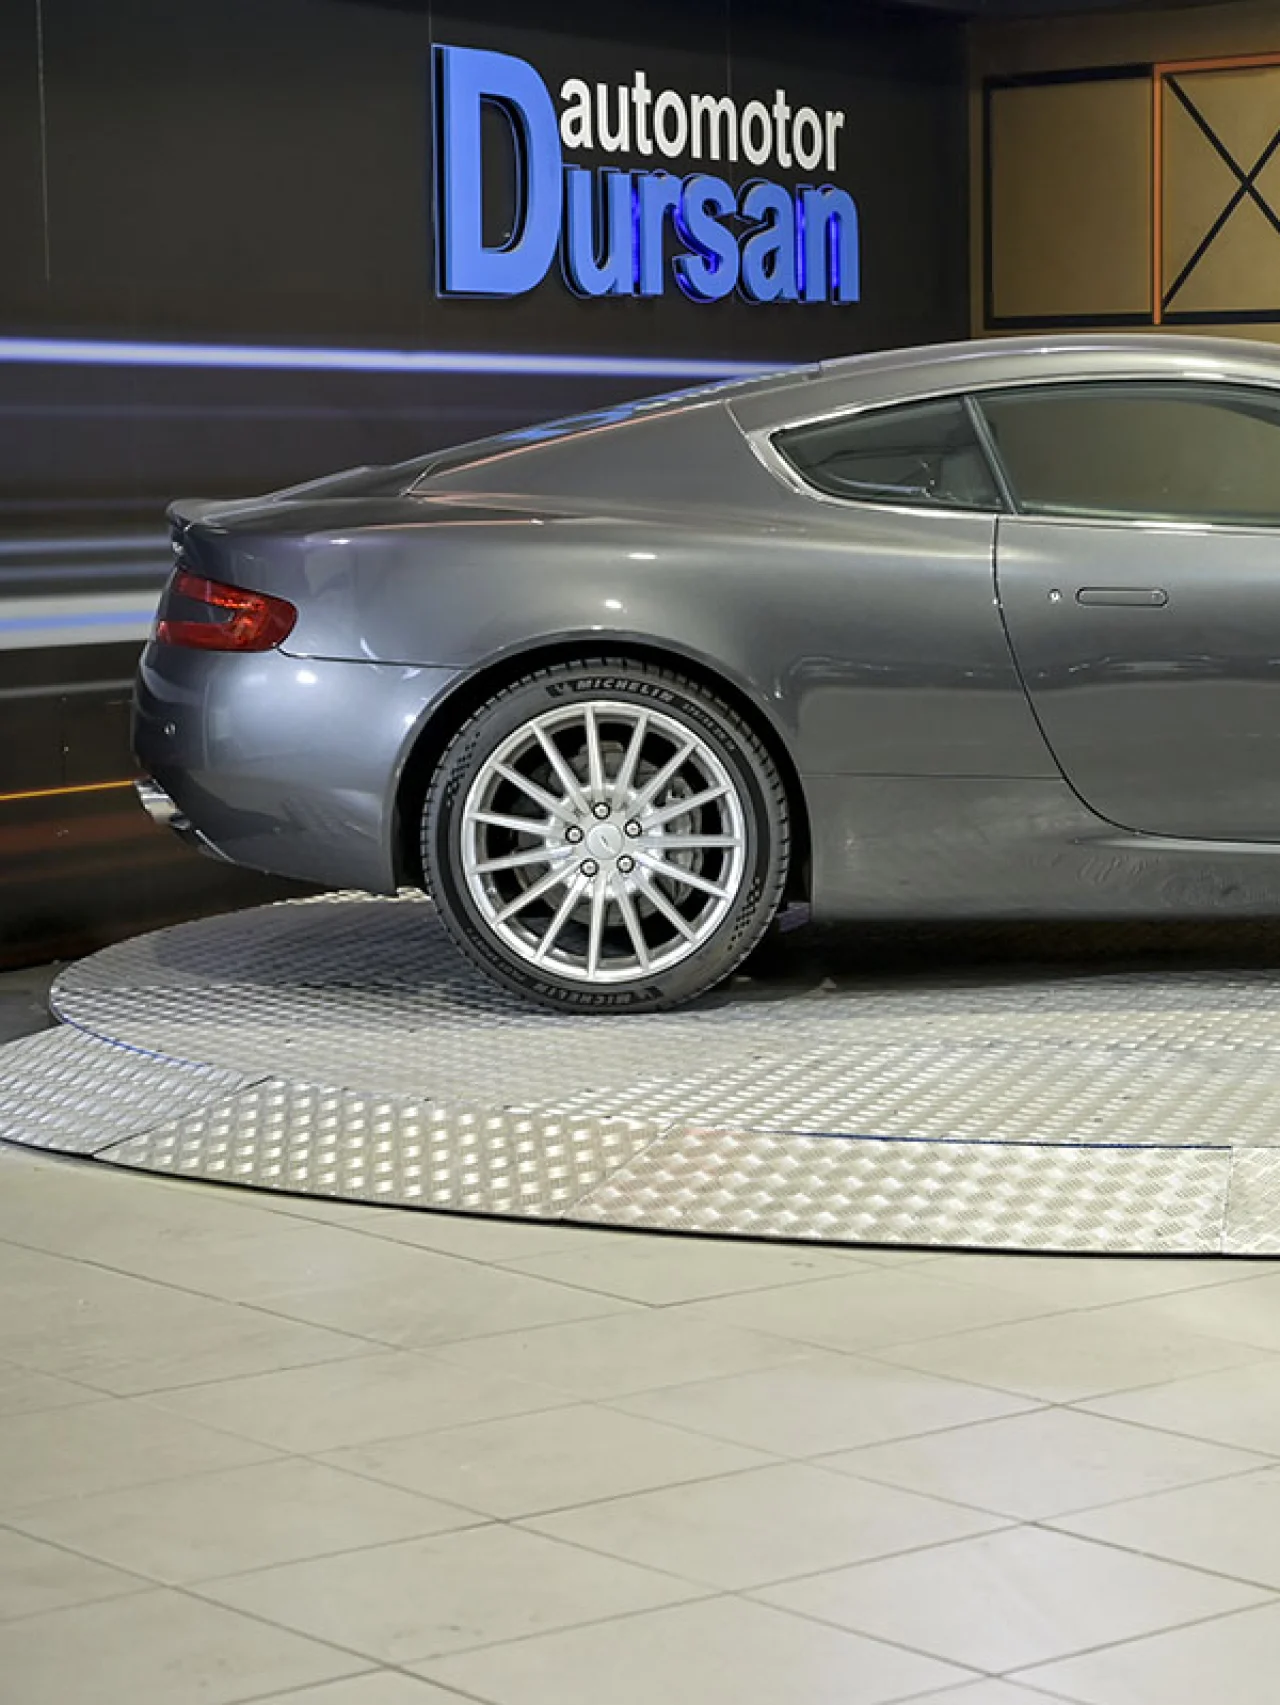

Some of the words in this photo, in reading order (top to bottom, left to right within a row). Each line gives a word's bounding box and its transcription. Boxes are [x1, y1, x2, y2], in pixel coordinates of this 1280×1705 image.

[560, 70, 845, 171] automotor
[431, 43, 860, 304] Dursan
[576, 678, 674, 702] MICHELIN
